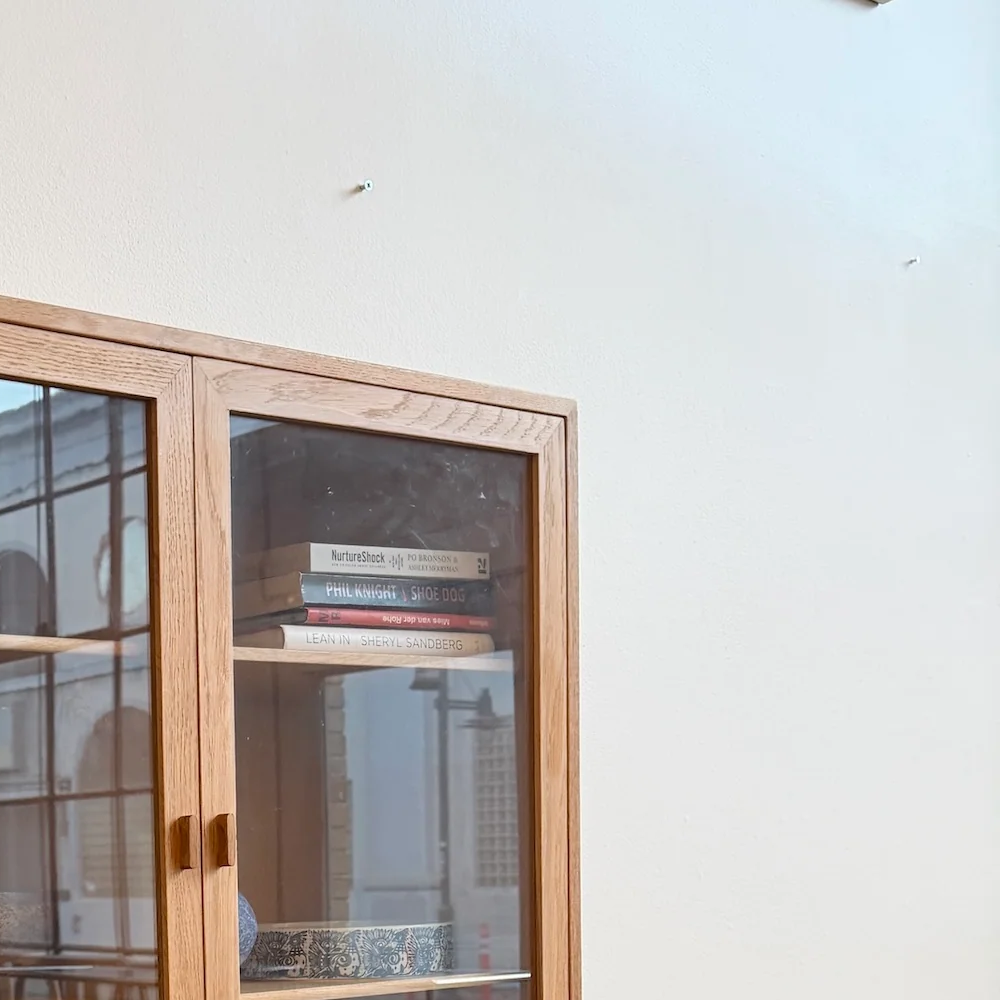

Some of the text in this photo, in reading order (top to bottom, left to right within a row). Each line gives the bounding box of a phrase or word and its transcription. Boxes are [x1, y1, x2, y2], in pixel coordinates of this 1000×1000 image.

[331, 549, 385, 564] NurtureShock
[418, 554, 451, 563] BRONSON
[326, 581, 465, 602] PHIL KNIGHT SHOE DOG
[382, 615, 450, 626] Mies van der Rohe
[305, 632, 463, 651] LEAN IN SHERYL SANDBERG
